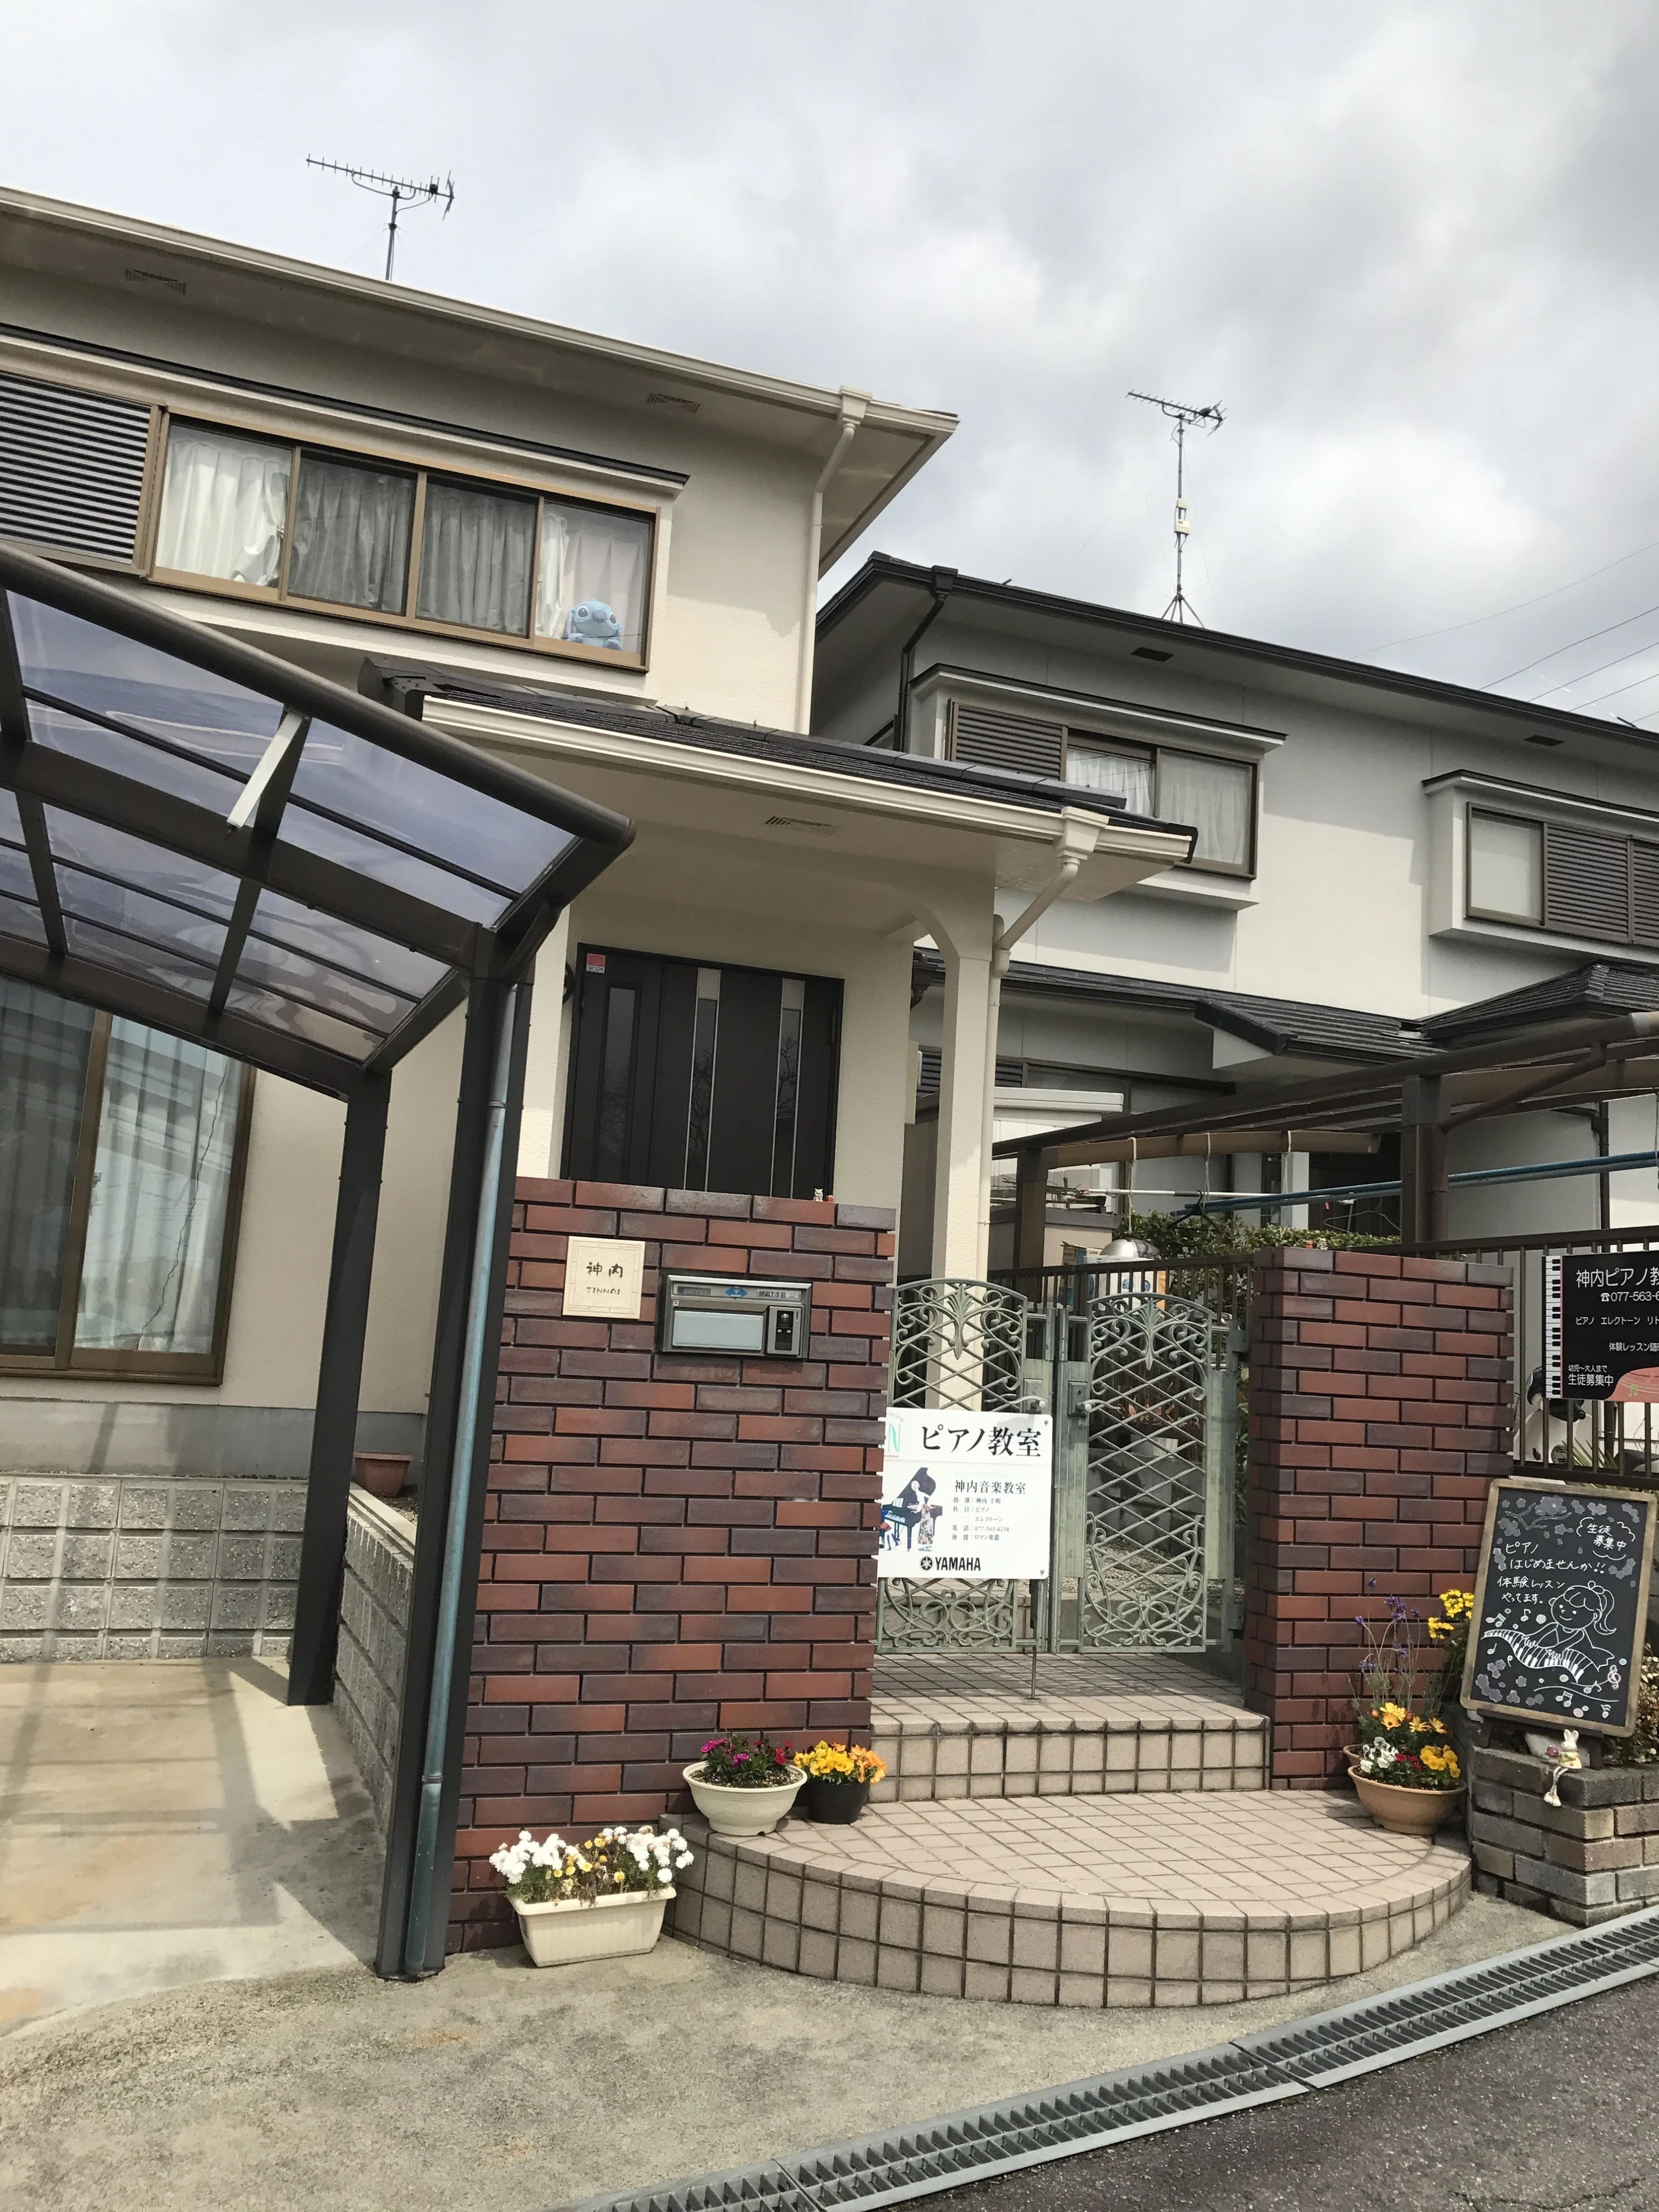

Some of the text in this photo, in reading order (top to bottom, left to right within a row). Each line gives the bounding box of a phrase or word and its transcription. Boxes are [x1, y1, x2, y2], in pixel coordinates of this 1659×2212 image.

[586, 1262, 623, 1278] 神内
[1576, 1266, 1659, 1288] 神内ピアノ教
[1576, 1317, 1594, 1325] ピアノ
[1600, 1317, 1640, 1325] エレクトーン
[1568, 1373, 1614, 1386] 生徒募集中
[922, 1424, 1041, 1457] ピアノ教室
[954, 1480, 1026, 1494] 神内音楽教室
[1587, 1523, 1612, 1536] 生徒
[1506, 1541, 1539, 1554] ピアノ
[1593, 1535, 1627, 1551] 募集中
[935, 1557, 981, 1571] YAMAHA
[1496, 1575, 1566, 1588] 体験レッスン
[1501, 1592, 1543, 1604] やってます。
